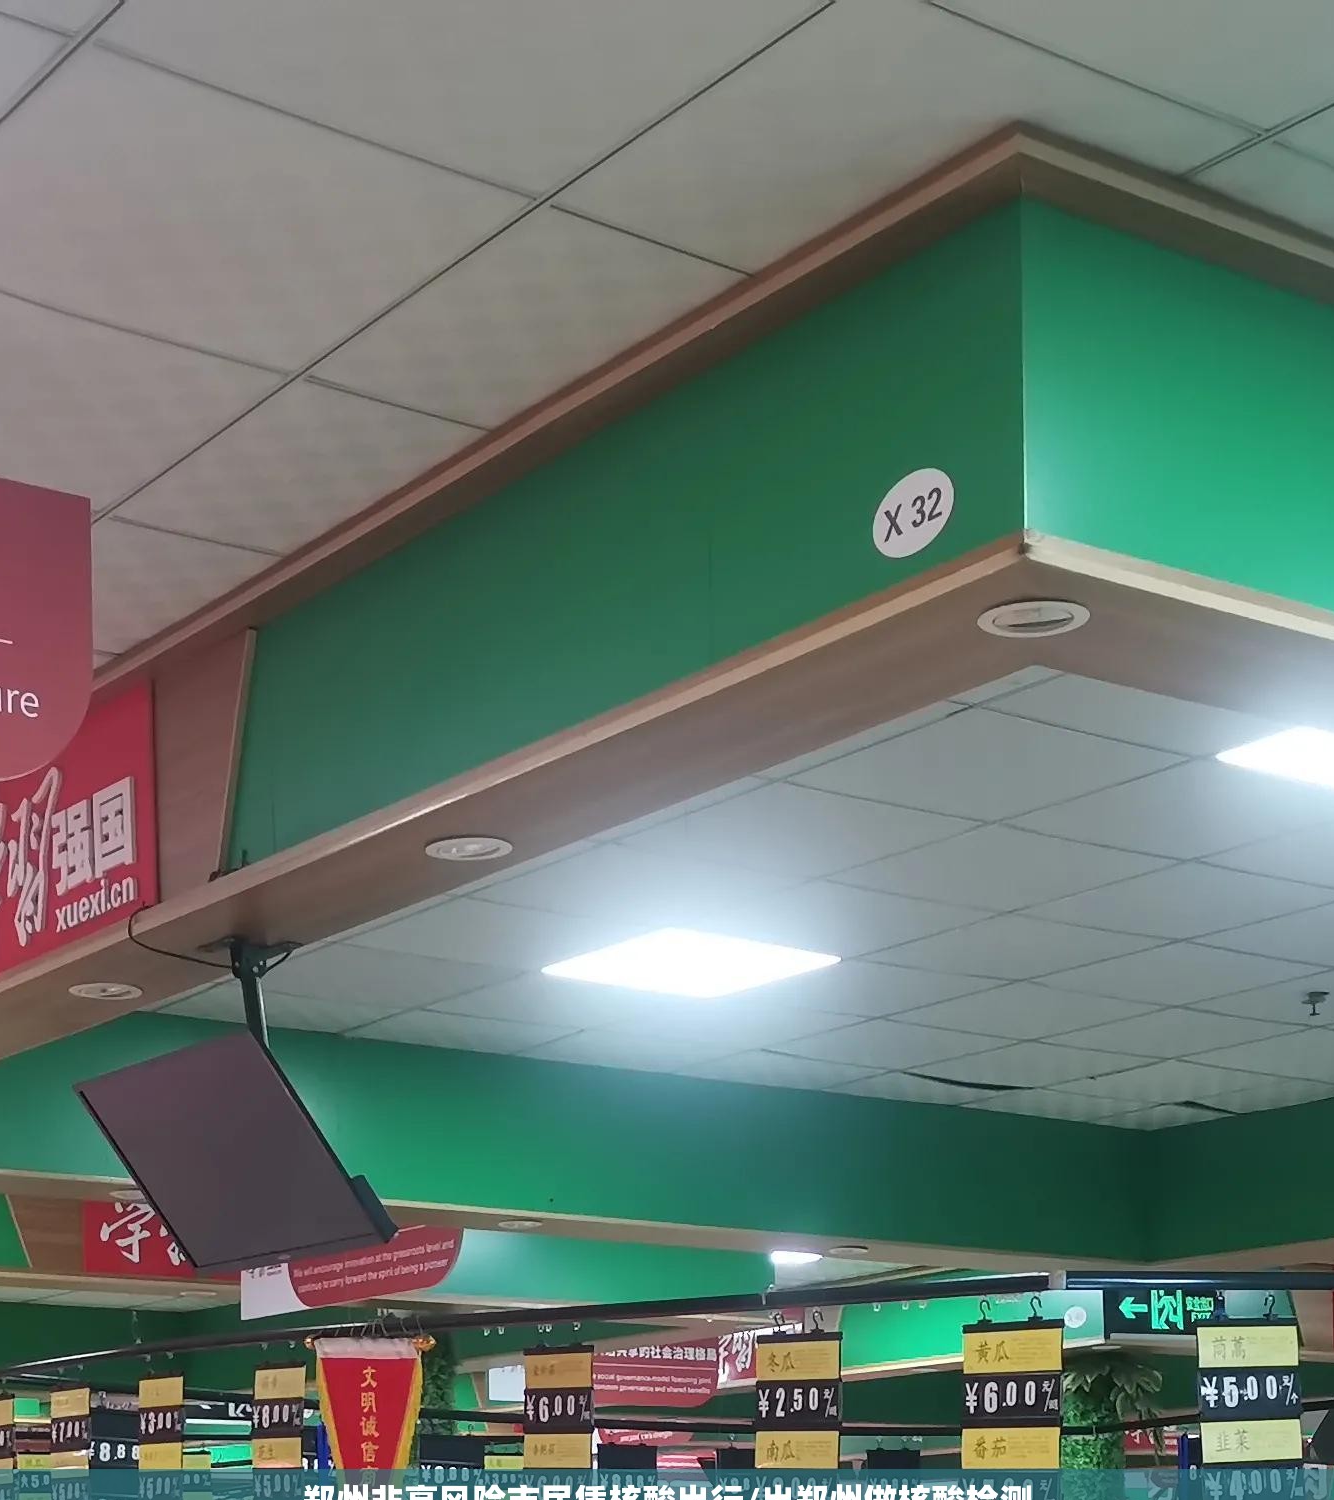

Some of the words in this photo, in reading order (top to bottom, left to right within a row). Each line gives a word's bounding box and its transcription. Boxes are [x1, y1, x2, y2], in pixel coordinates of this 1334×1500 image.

[883, 503, 903, 542] X
[911, 487, 942, 528] 32
[55, 876, 138, 932] xuexi.cn
[768, 1351, 795, 1372] 冬瓜
[975, 1340, 1009, 1363] 黄瓜
